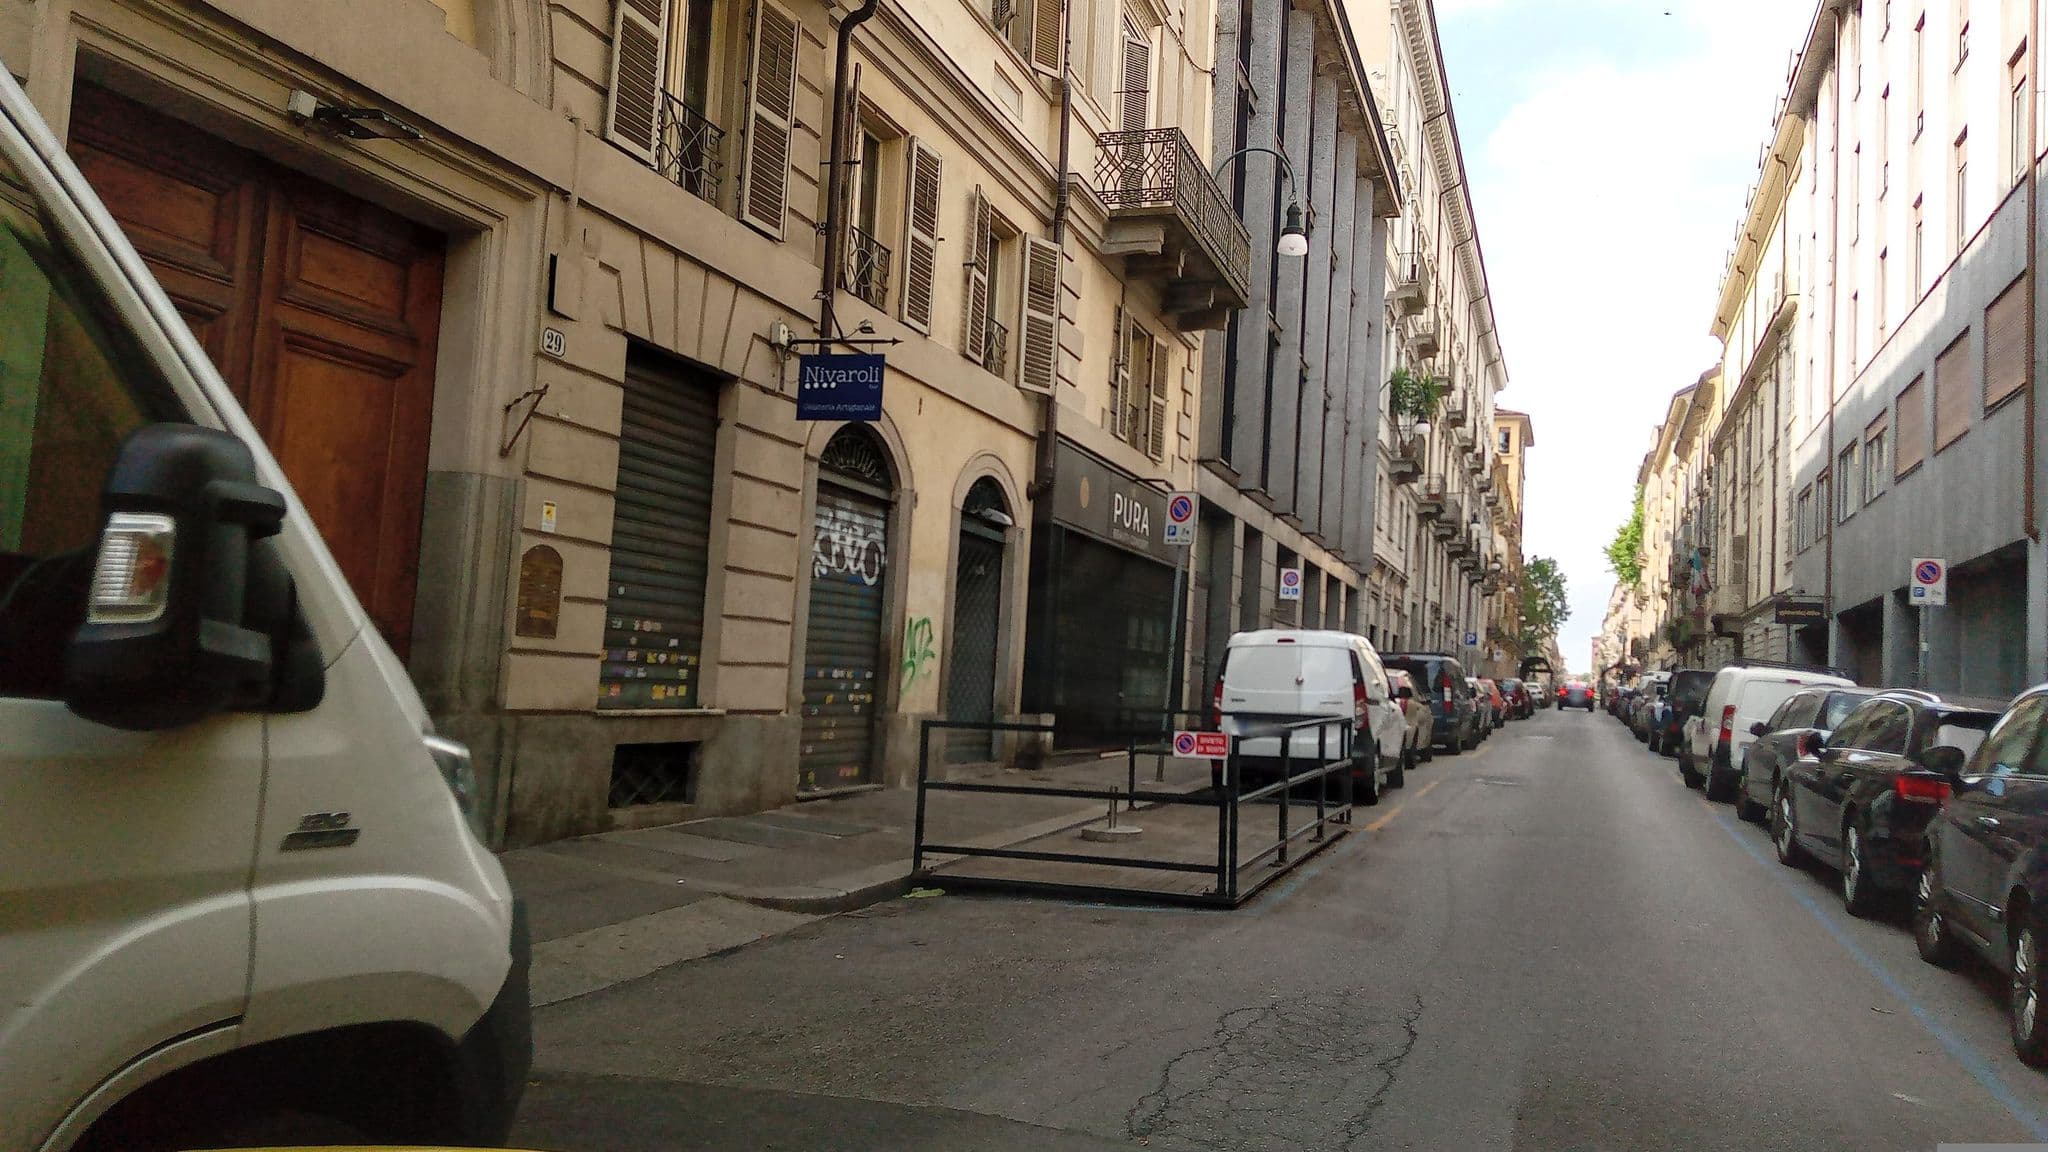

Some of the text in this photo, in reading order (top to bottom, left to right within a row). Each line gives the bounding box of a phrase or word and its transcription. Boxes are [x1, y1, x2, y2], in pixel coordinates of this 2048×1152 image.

[546, 331, 562, 352] 29
[805, 366, 880, 383] Nivaroli
[1113, 492, 1150, 537] PURA
